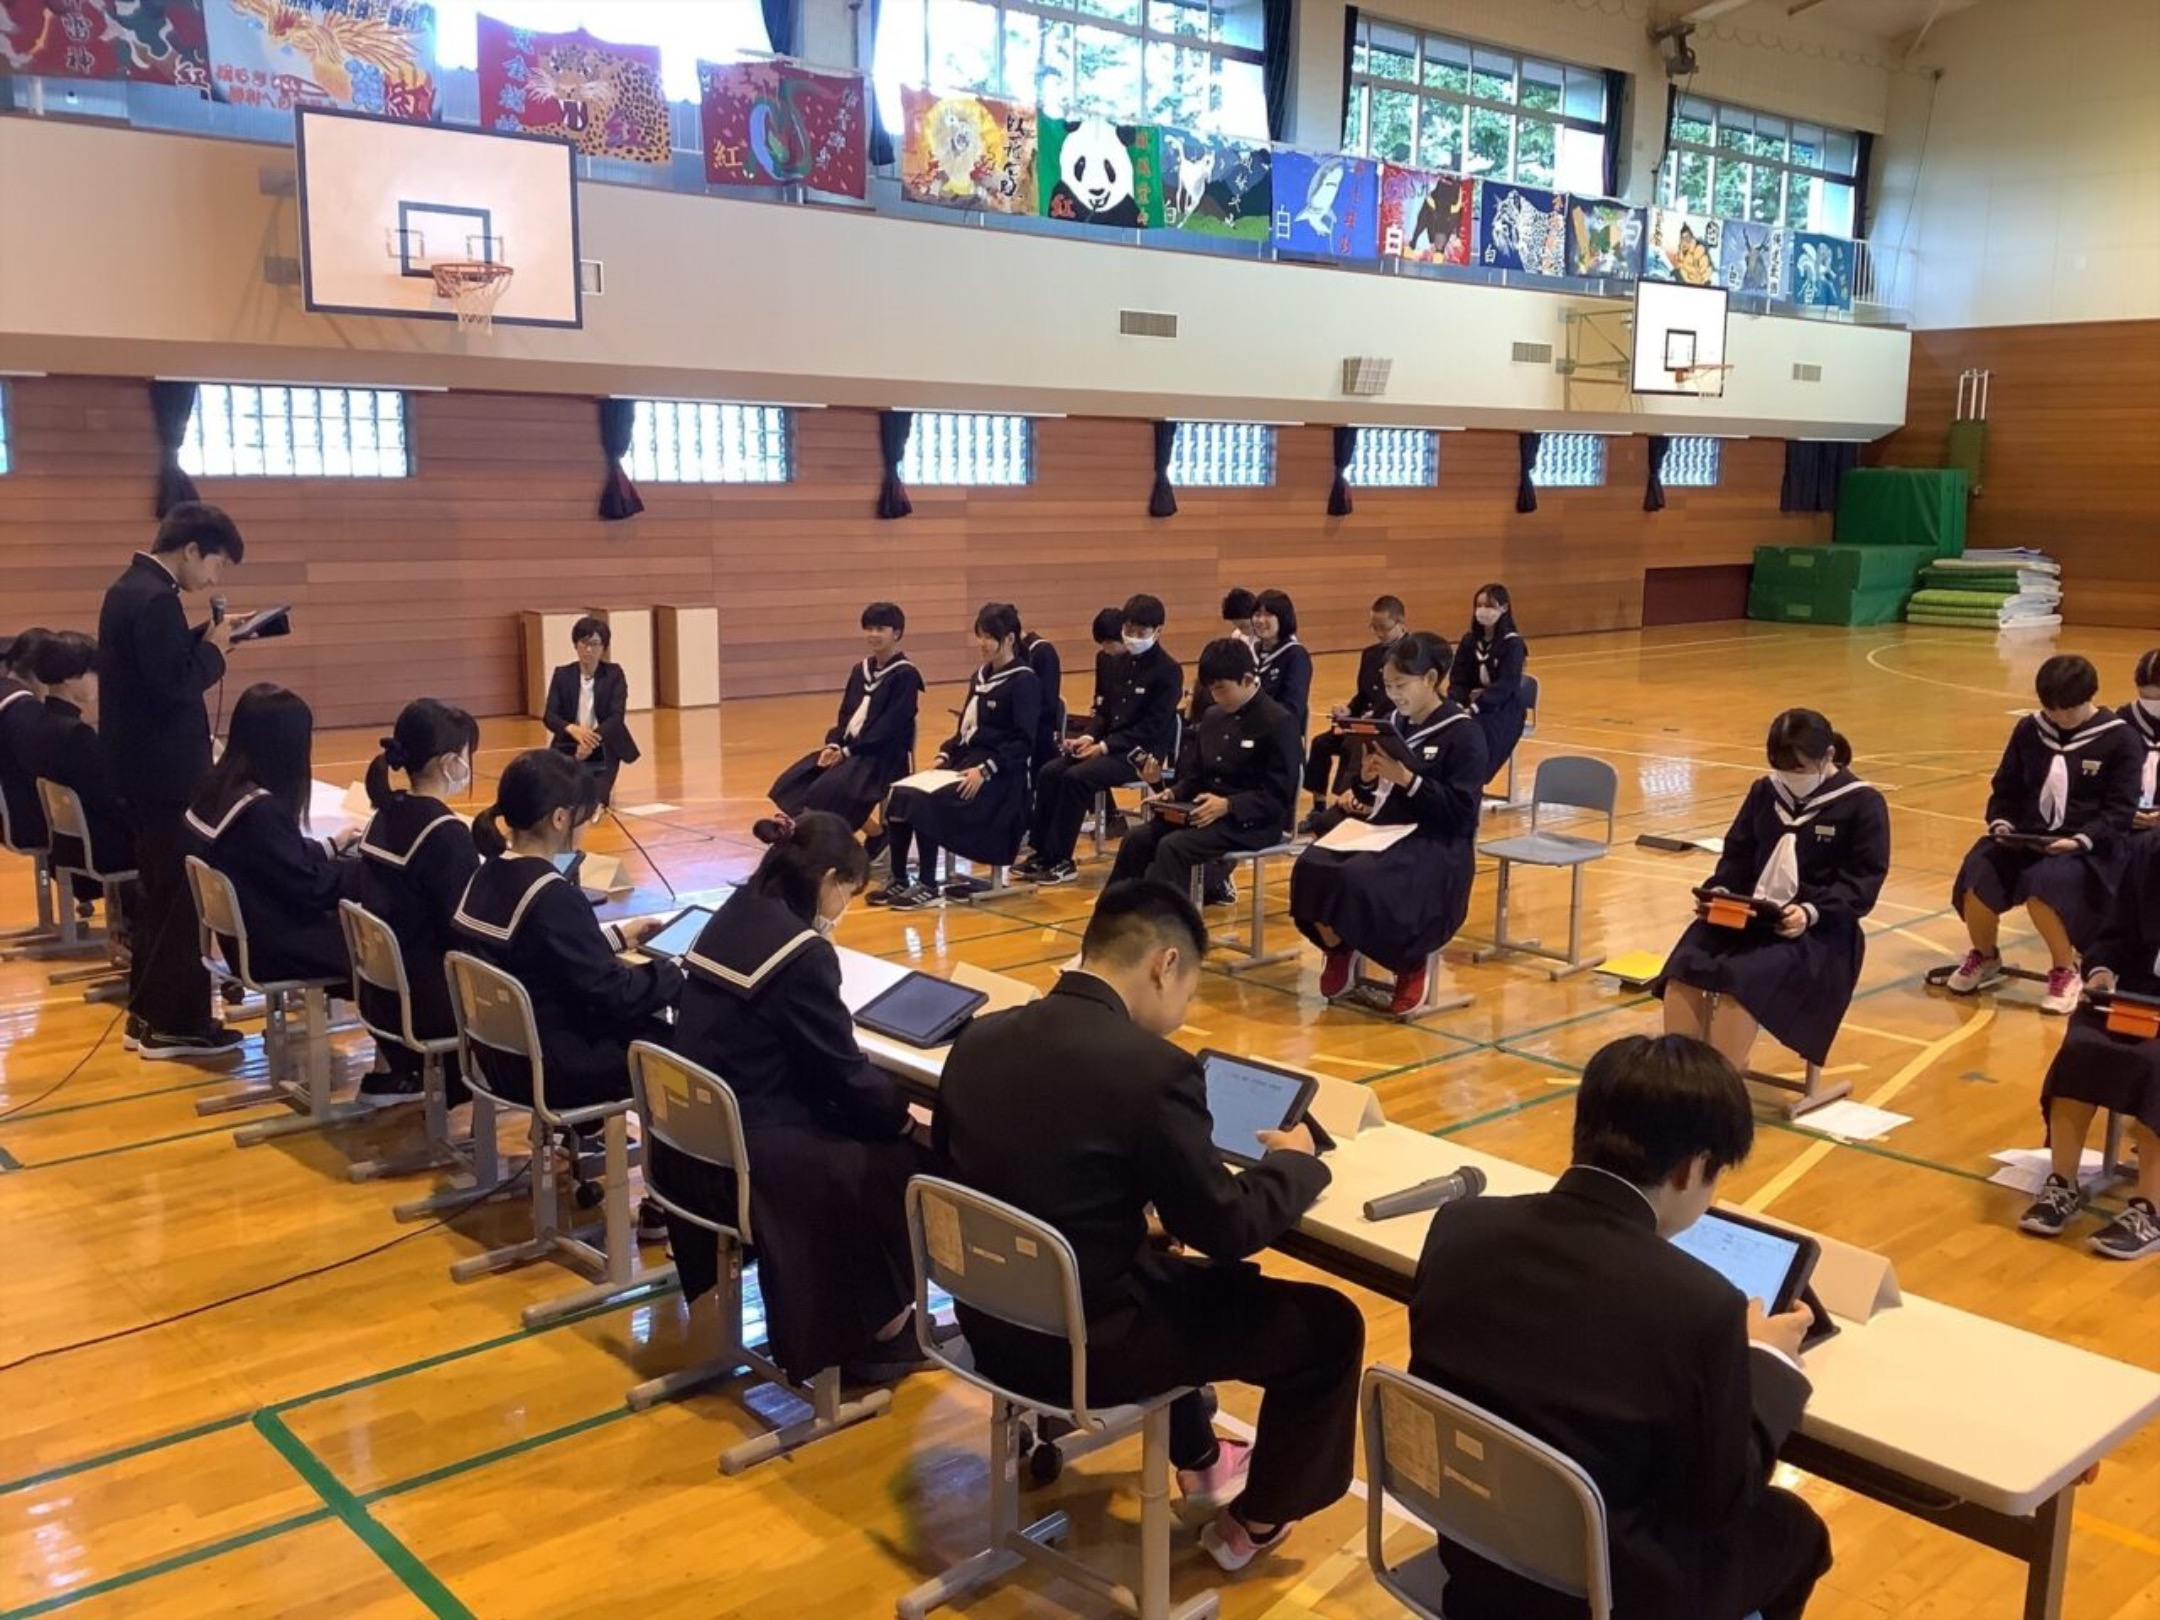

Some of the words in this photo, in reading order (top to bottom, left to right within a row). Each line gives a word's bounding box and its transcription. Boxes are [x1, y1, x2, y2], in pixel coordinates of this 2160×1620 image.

[713, 140, 743, 170] 紅
[1050, 193, 1076, 218] 紅
[1164, 199, 1177, 225] 白
[1276, 204, 1291, 241] 白
[1622, 208, 1643, 250] 白
[1384, 223, 1403, 256] 白
[1484, 244, 1497, 265] 白
